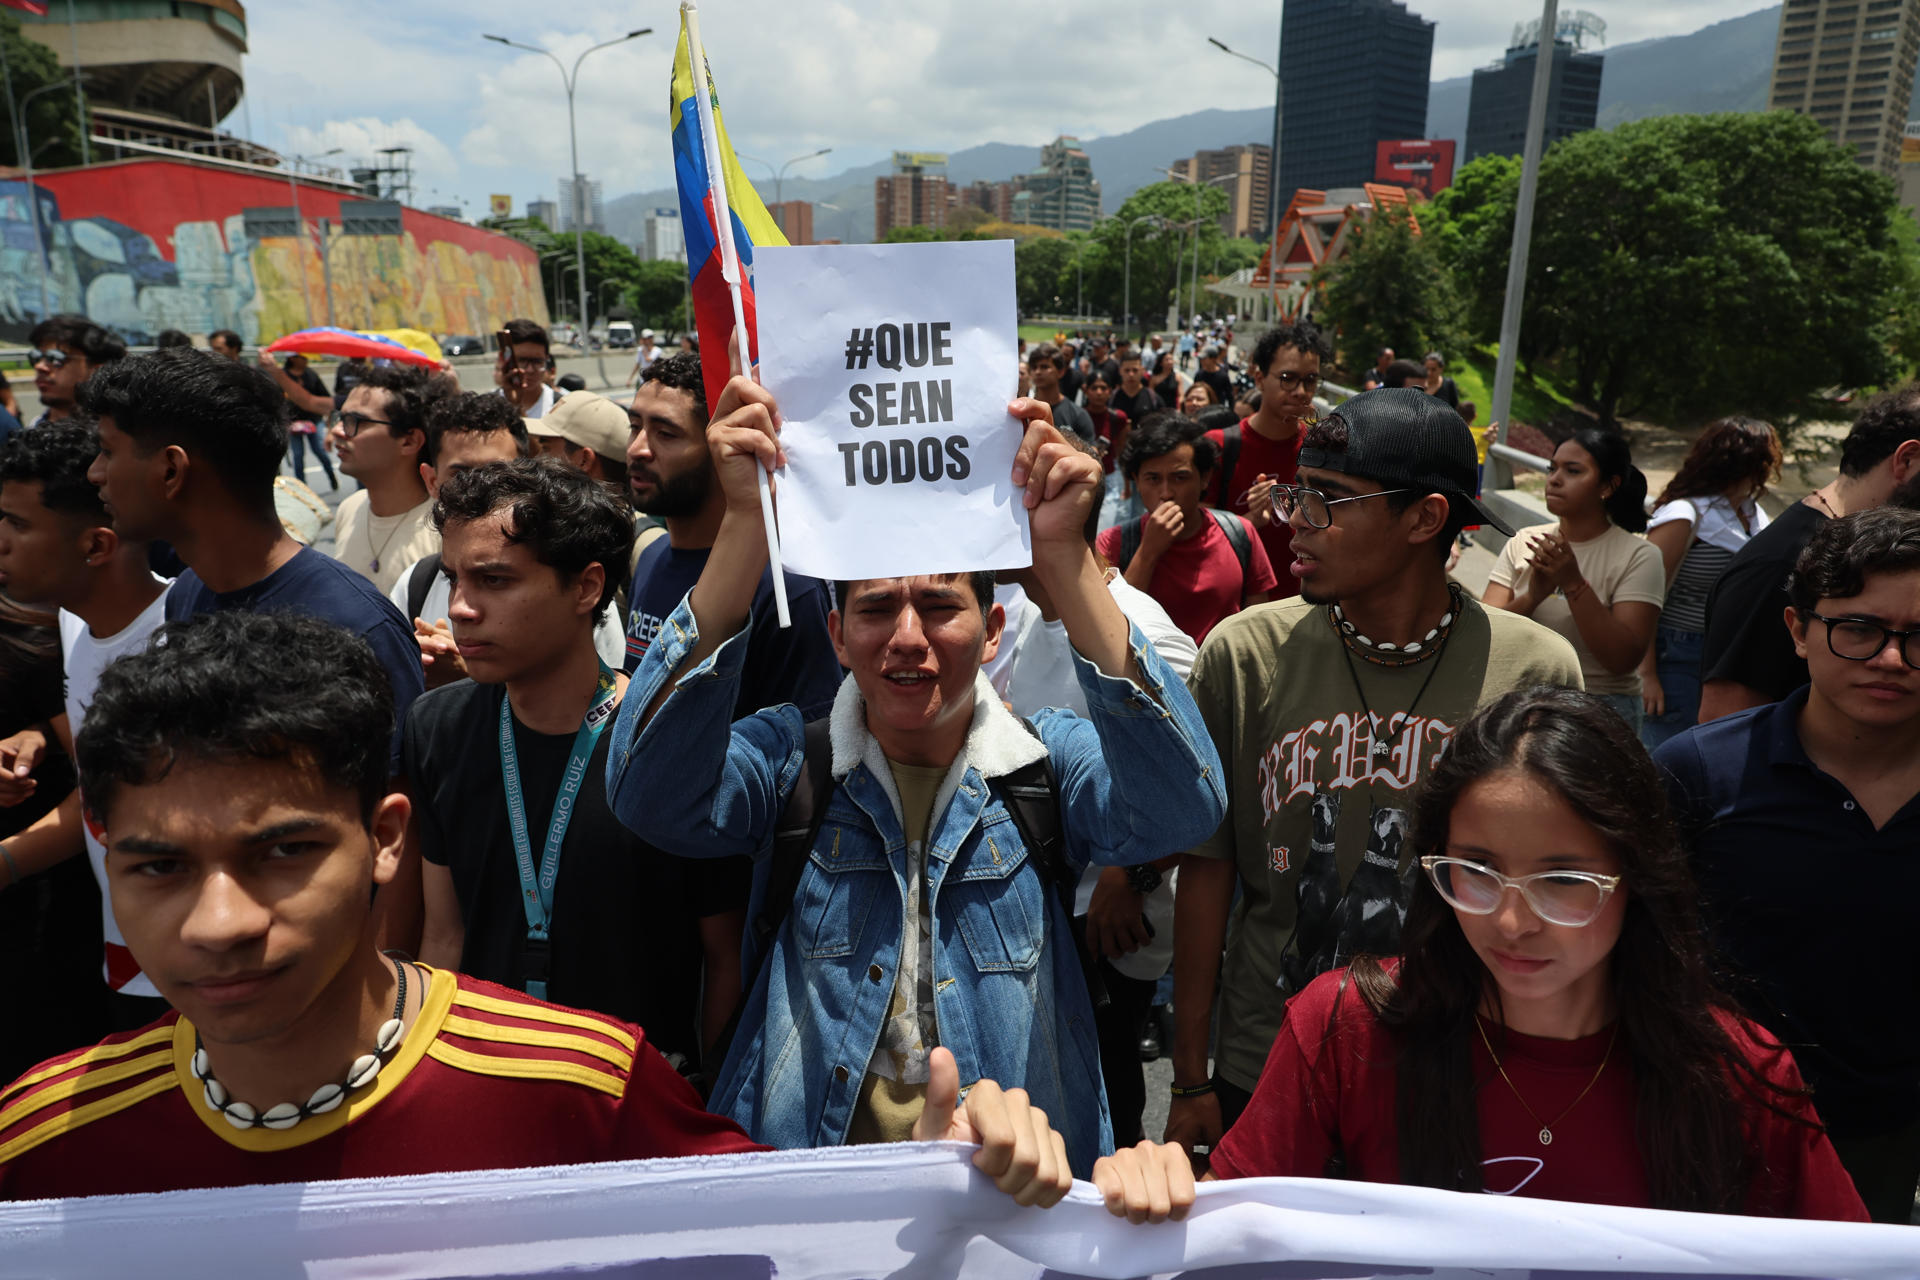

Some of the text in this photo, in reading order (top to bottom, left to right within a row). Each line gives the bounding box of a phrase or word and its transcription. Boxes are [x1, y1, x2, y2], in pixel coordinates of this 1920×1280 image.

[845, 322, 953, 372] #QUE
[849, 379, 953, 428] SEAN
[838, 435, 971, 487] TODOS
[586, 696, 615, 723] CEE
[502, 717, 513, 753] ESTUDIOS
[505, 764, 520, 795] ESCUELA
[510, 795, 526, 842] ESTUDIANTES
[541, 796, 571, 889] GUILLERMO
[520, 854, 533, 882] CENTRO
